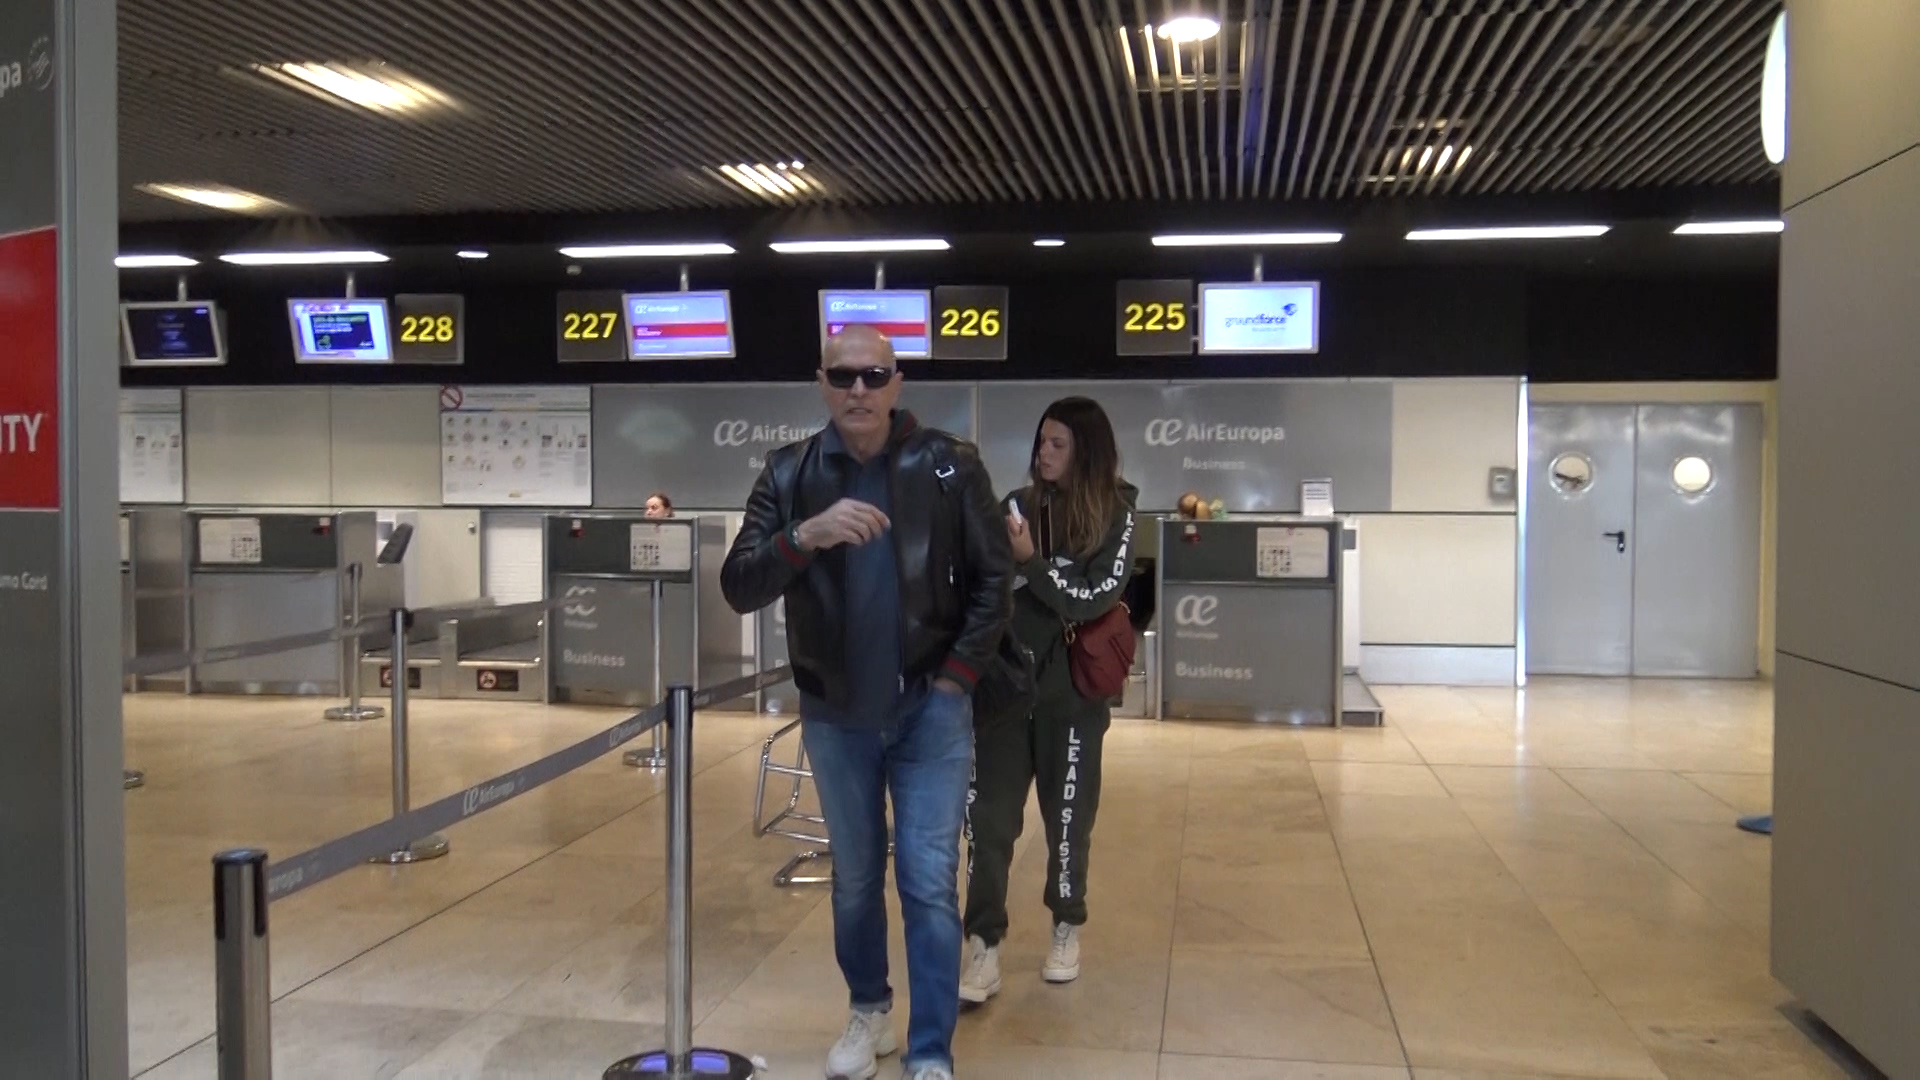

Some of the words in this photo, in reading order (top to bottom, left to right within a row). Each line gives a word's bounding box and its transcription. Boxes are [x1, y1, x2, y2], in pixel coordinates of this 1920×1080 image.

[401, 316, 453, 342] 228
[563, 313, 618, 339] 227
[940, 309, 1000, 337] 226
[1124, 303, 1186, 331] 225
[1185, 423, 1285, 443] AirEuropa
[1183, 456, 1247, 471] Business
[563, 649, 626, 668] Business
[1175, 662, 1253, 680] Business
[1064, 726, 1081, 801] LEAD
[1059, 806, 1074, 899] SISTER
